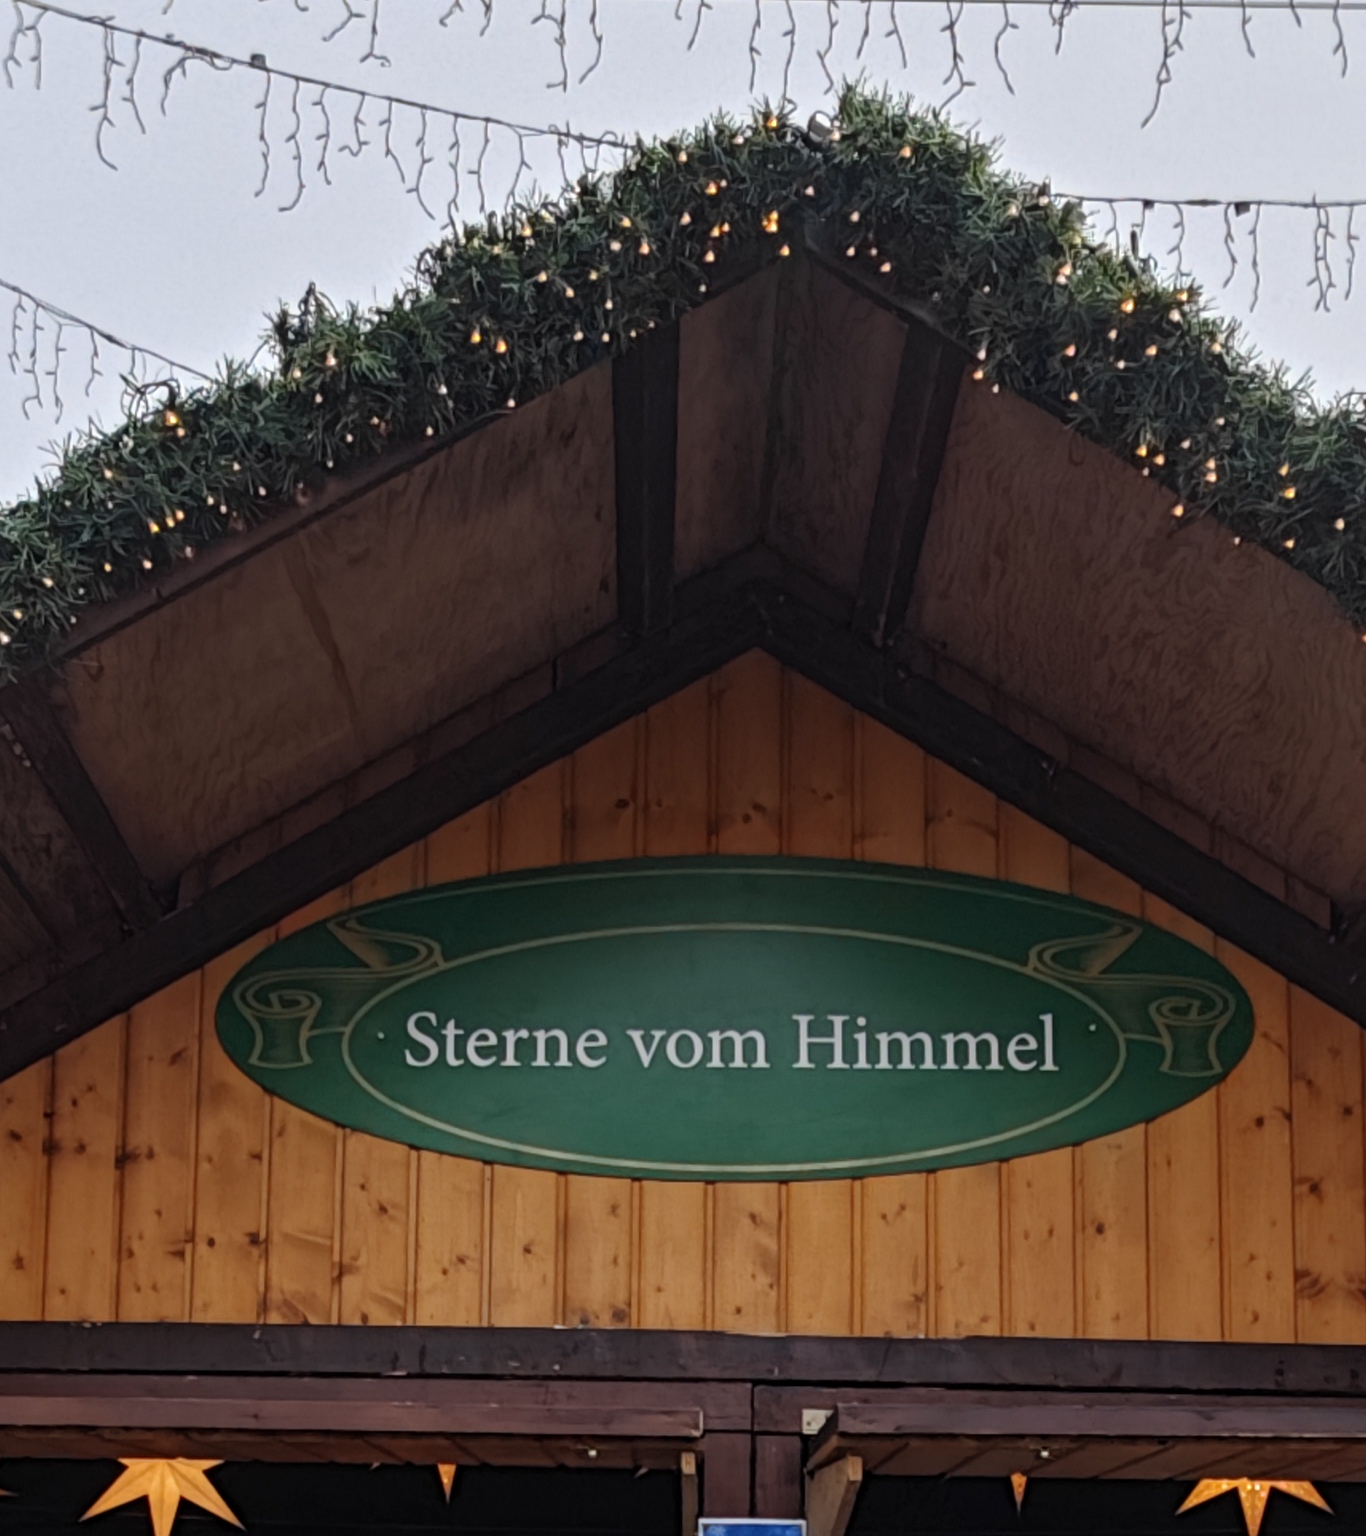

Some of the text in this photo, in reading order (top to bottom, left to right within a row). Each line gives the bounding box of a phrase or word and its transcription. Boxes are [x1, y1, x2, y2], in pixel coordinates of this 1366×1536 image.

[404, 1011, 1059, 1071] Sterne vom Himmel
